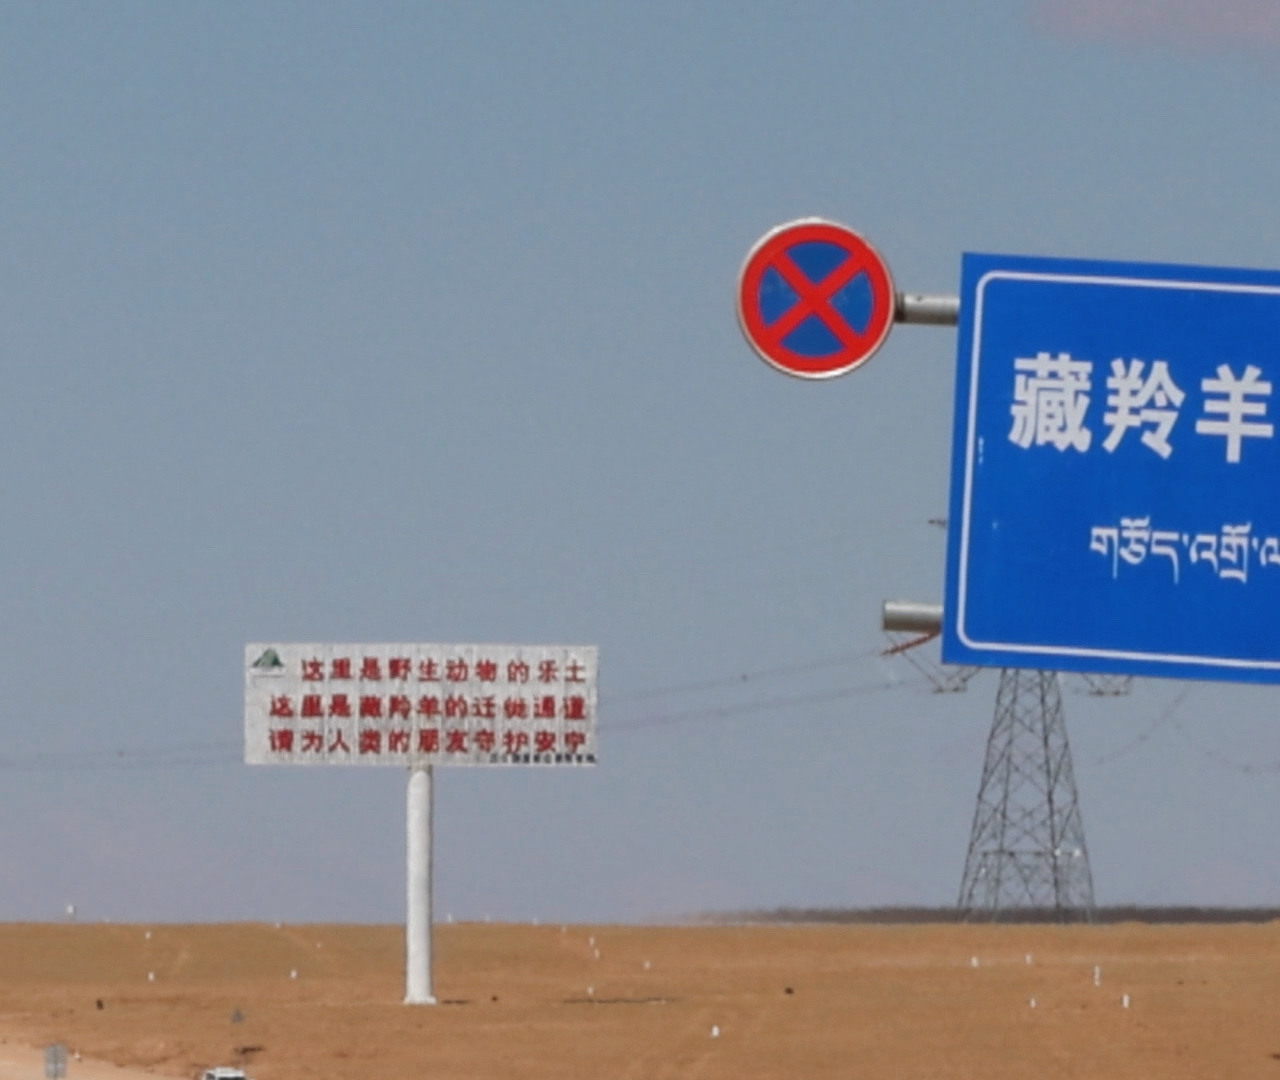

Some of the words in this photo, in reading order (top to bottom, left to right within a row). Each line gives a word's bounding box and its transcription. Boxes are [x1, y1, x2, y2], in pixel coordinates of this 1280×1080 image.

[301, 656, 586, 683] 这里是野生动物的乐土
[269, 693, 586, 720] 这里是藏羚羊的迁徙通道
[269, 728, 586, 755] 请为人类的朋友守护安宁
